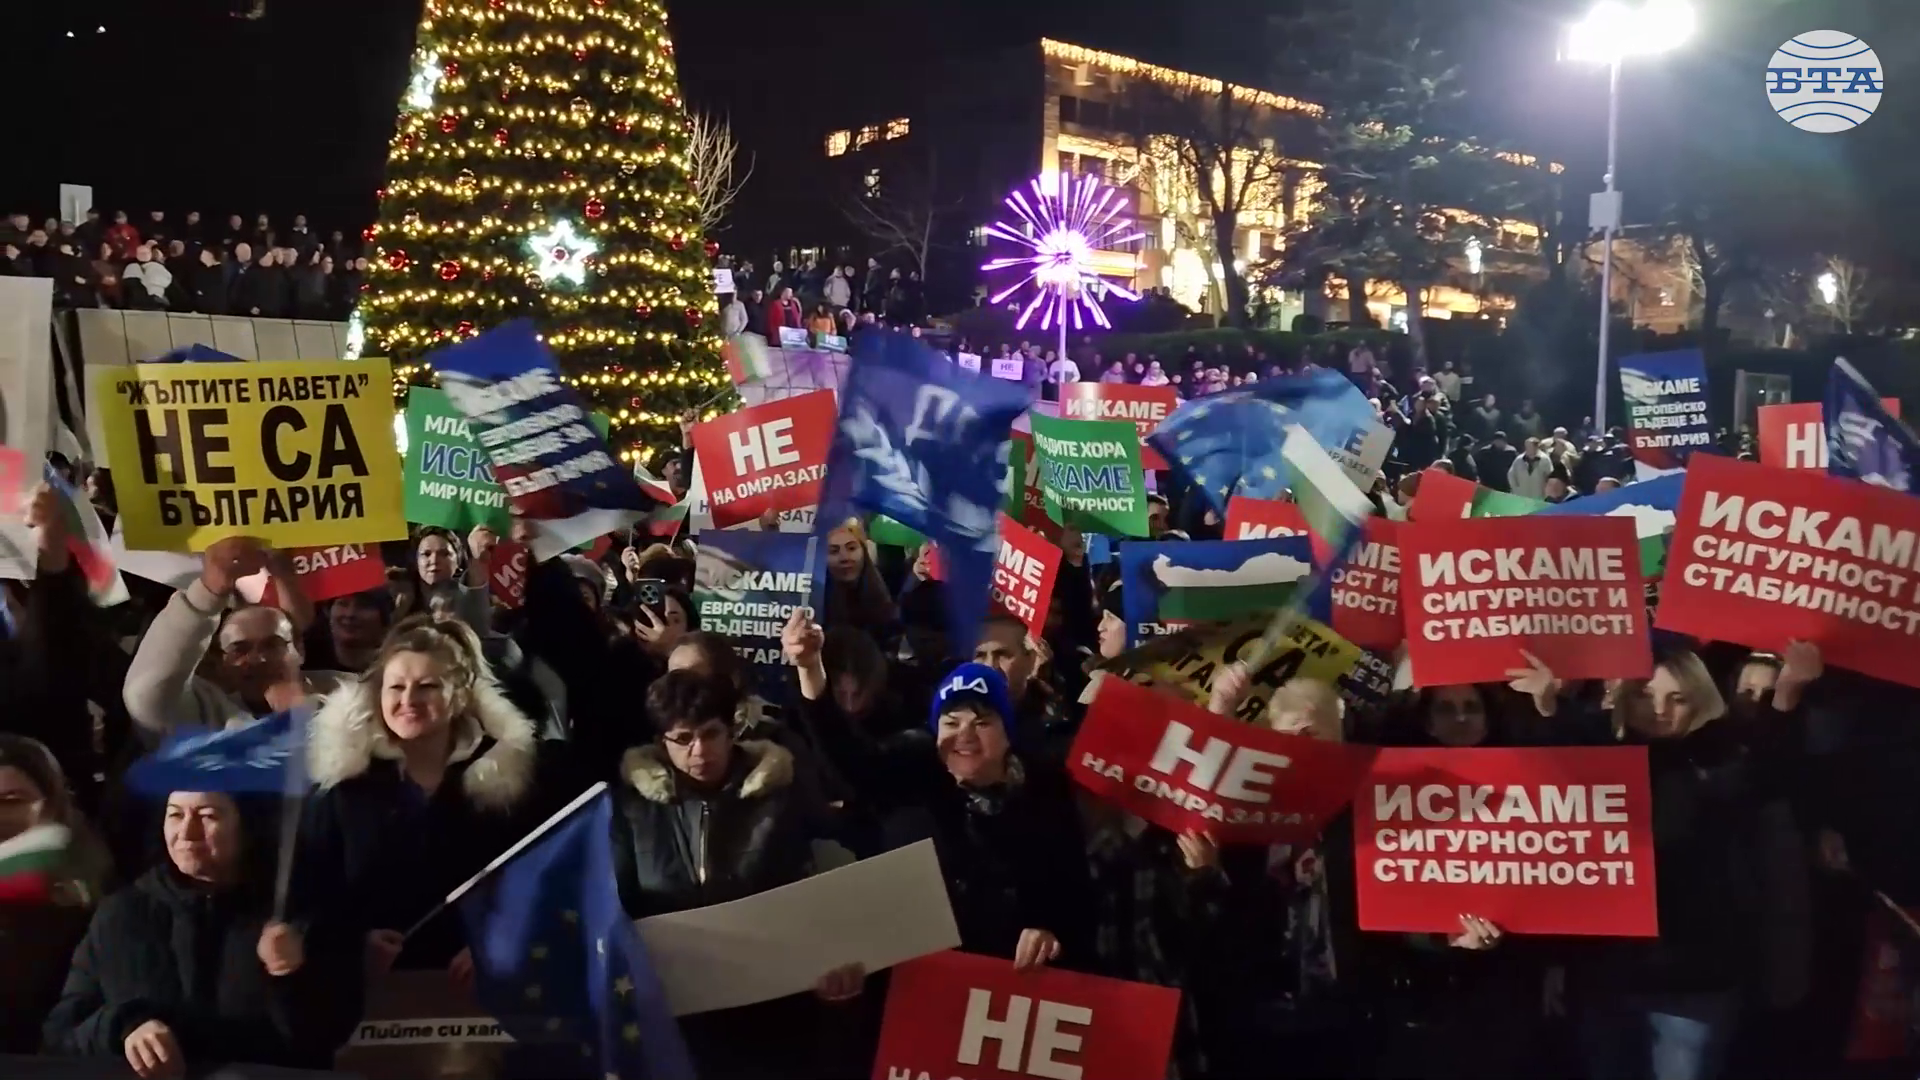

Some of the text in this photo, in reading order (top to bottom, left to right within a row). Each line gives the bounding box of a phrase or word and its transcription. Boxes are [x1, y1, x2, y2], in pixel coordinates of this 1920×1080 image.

[1632, 400, 1707, 416] ЕВРОПЕЙСКО
[1634, 413, 1708, 429] БЪДЕЩЕ ЗА
[134, 403, 370, 485] НЕ СА
[728, 417, 800, 476] НЕ
[1080, 441, 1127, 459] ХОРА
[1635, 432, 1710, 448] БЪЛГАРИЯ
[158, 482, 365, 526] БЪЛГАРИЯ
[419, 480, 458, 500] МИР
[460, 487, 473, 503] И
[713, 486, 736, 506] НА
[1699, 490, 1920, 573] ИСКАМ
[1418, 547, 1626, 587] ИСКАМЕ
[1692, 534, 1908, 598] СИГУРНОСТ
[1022, 584, 1039, 605] И
[1382, 576, 1399, 595] И
[701, 601, 815, 620] ЕВРОПЕЙСО
[1422, 587, 1601, 615] СИГУРНОСТ
[1608, 587, 1628, 609] И
[701, 618, 782, 639] БЪДЕЩЕ
[1422, 613, 1634, 642] СТАБИЛНОСТ!
[1081, 752, 1124, 783] НА
[1149, 719, 1293, 804] НЕ
[1374, 784, 1629, 824] ИСКАМЕ
[1375, 828, 1630, 854] СИГУРНОСТ И
[1373, 858, 1635, 886] СТАБИЛНОСТ!
[437, 1024, 462, 1037] си
[957, 987, 1093, 1080] НЕ
